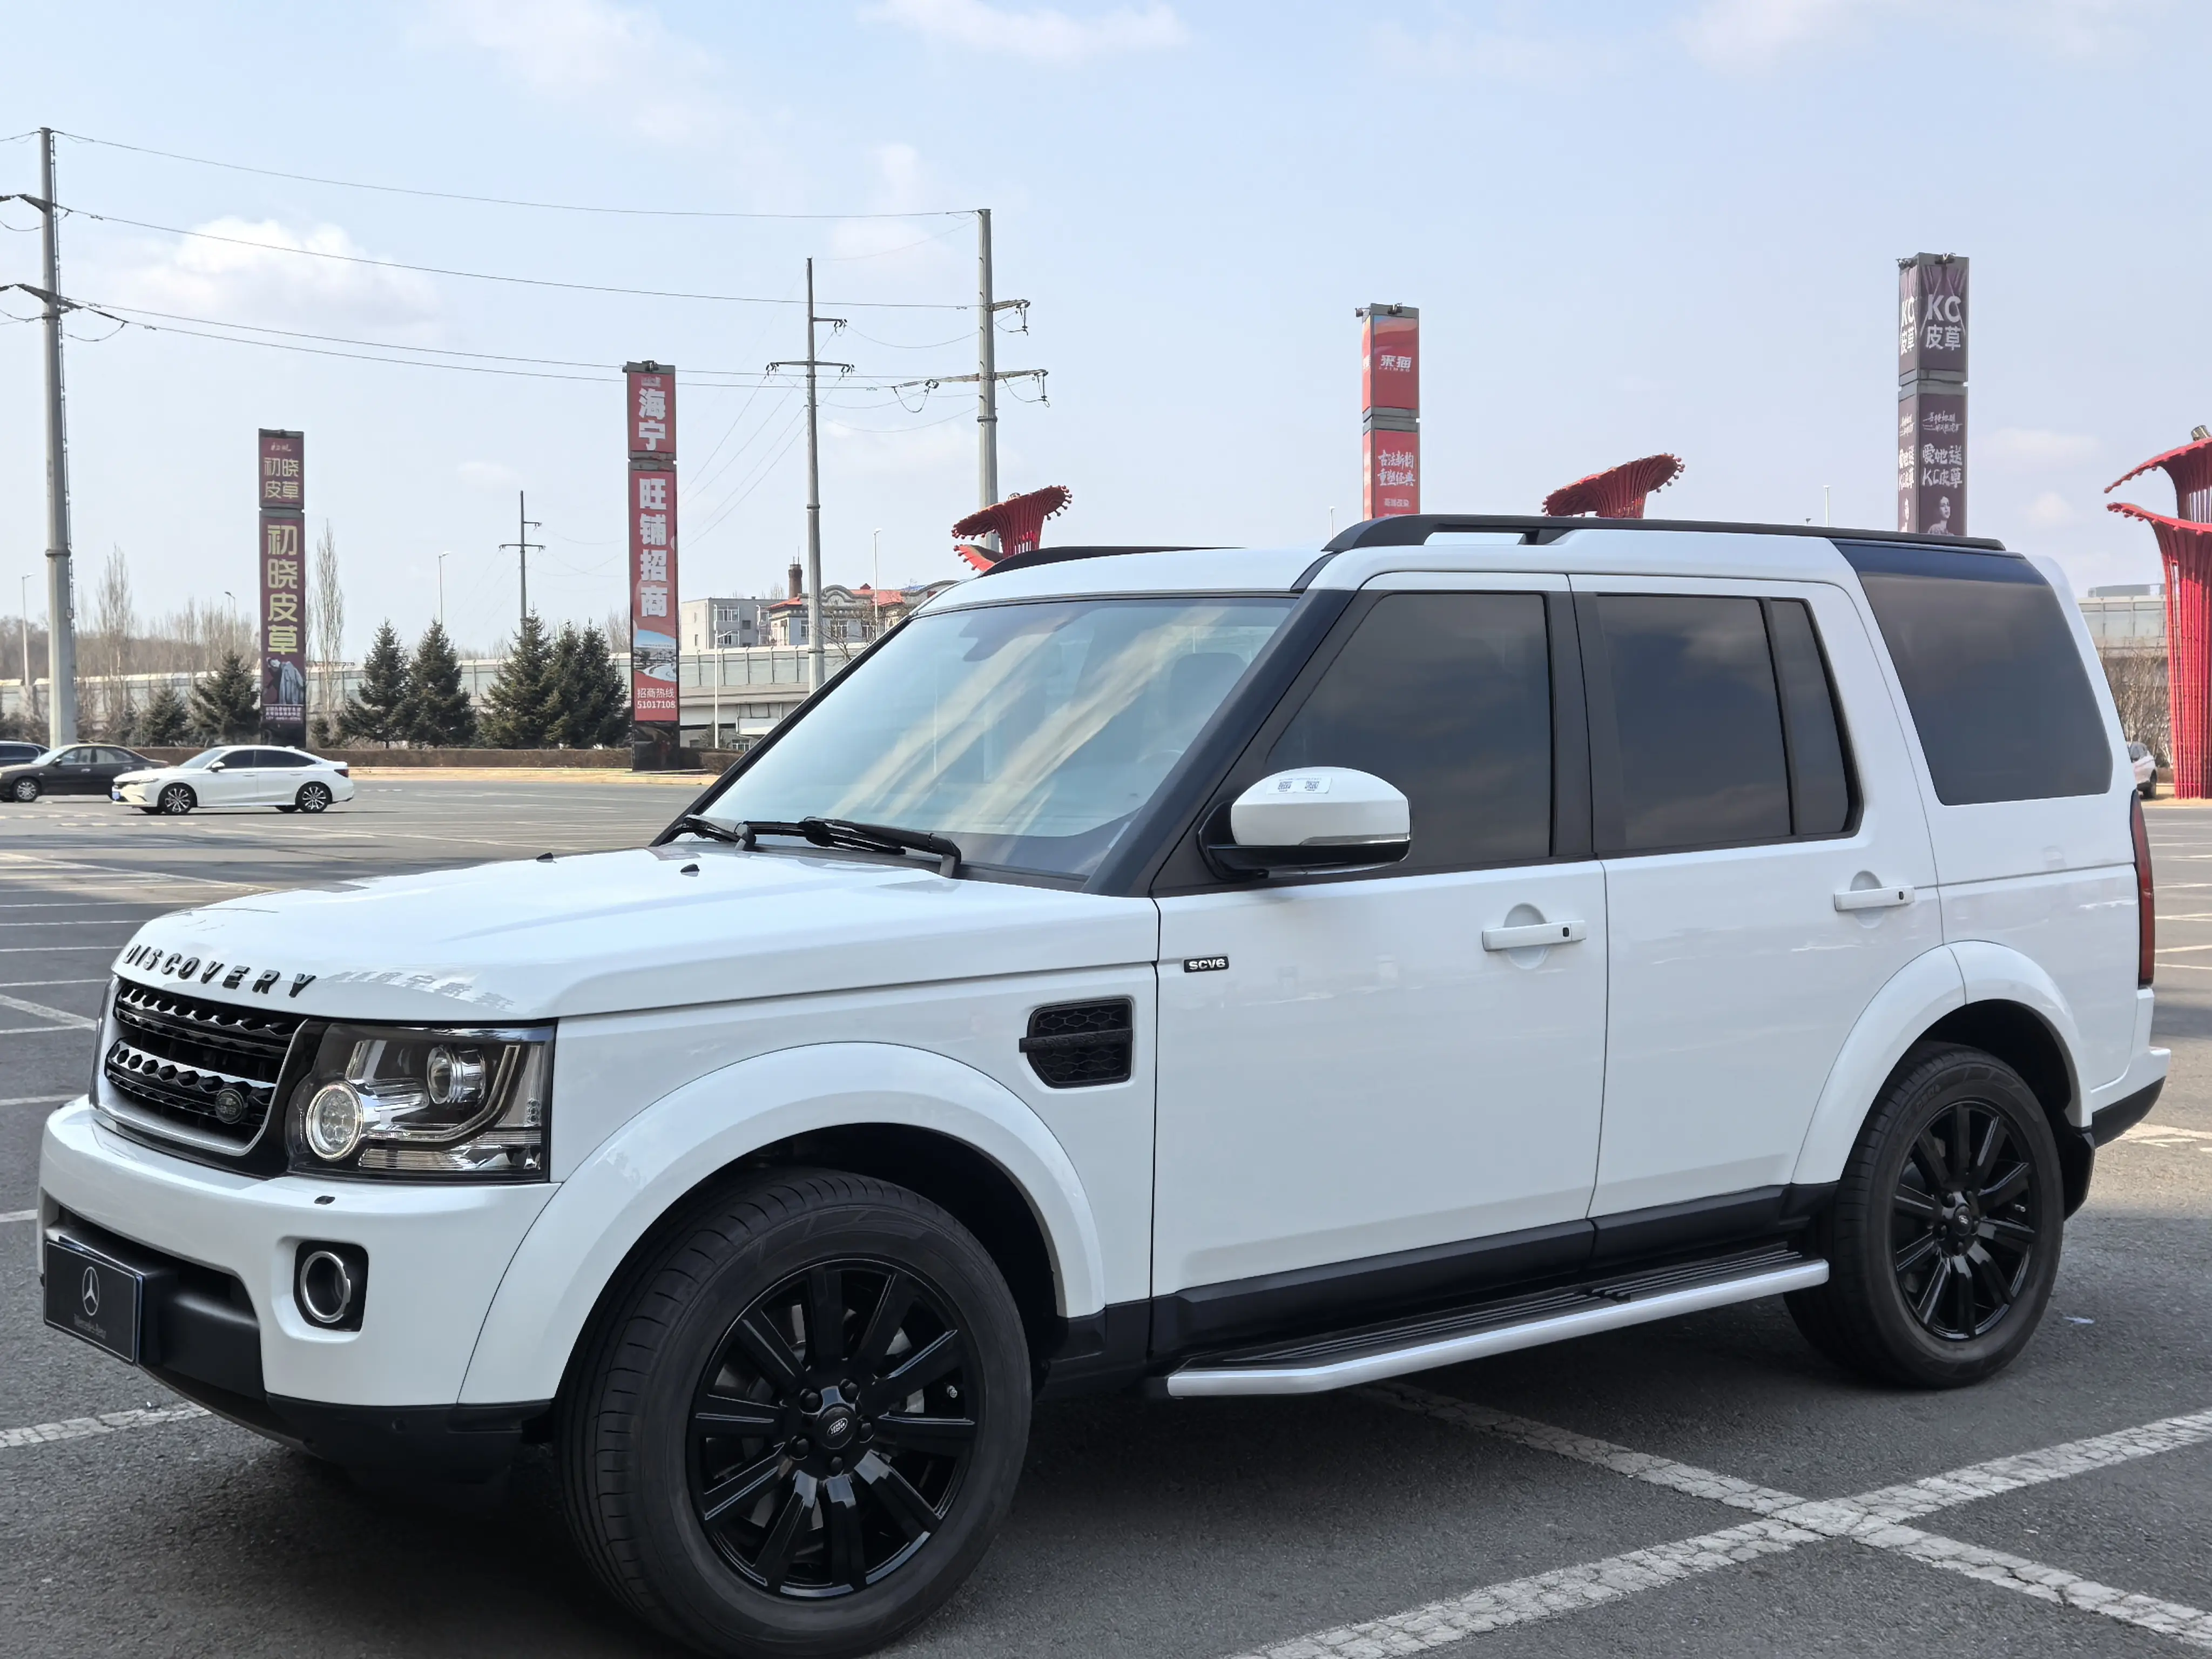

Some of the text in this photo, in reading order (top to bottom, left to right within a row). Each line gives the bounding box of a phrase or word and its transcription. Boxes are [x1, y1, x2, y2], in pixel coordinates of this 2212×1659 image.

[1927, 294, 1961, 323] KC
[1925, 324, 1961, 350] 皮草
[638, 388, 666, 450] 海宁
[264, 457, 299, 477] 初晓
[265, 480, 299, 499] 皮草
[639, 478, 667, 617] 旺铺招商
[267, 524, 298, 655] 初晓皮草
[637, 687, 675, 698] 招商热线
[122, 943, 316, 998] DISCOVERY
[1188, 958, 1225, 970] SCV6
